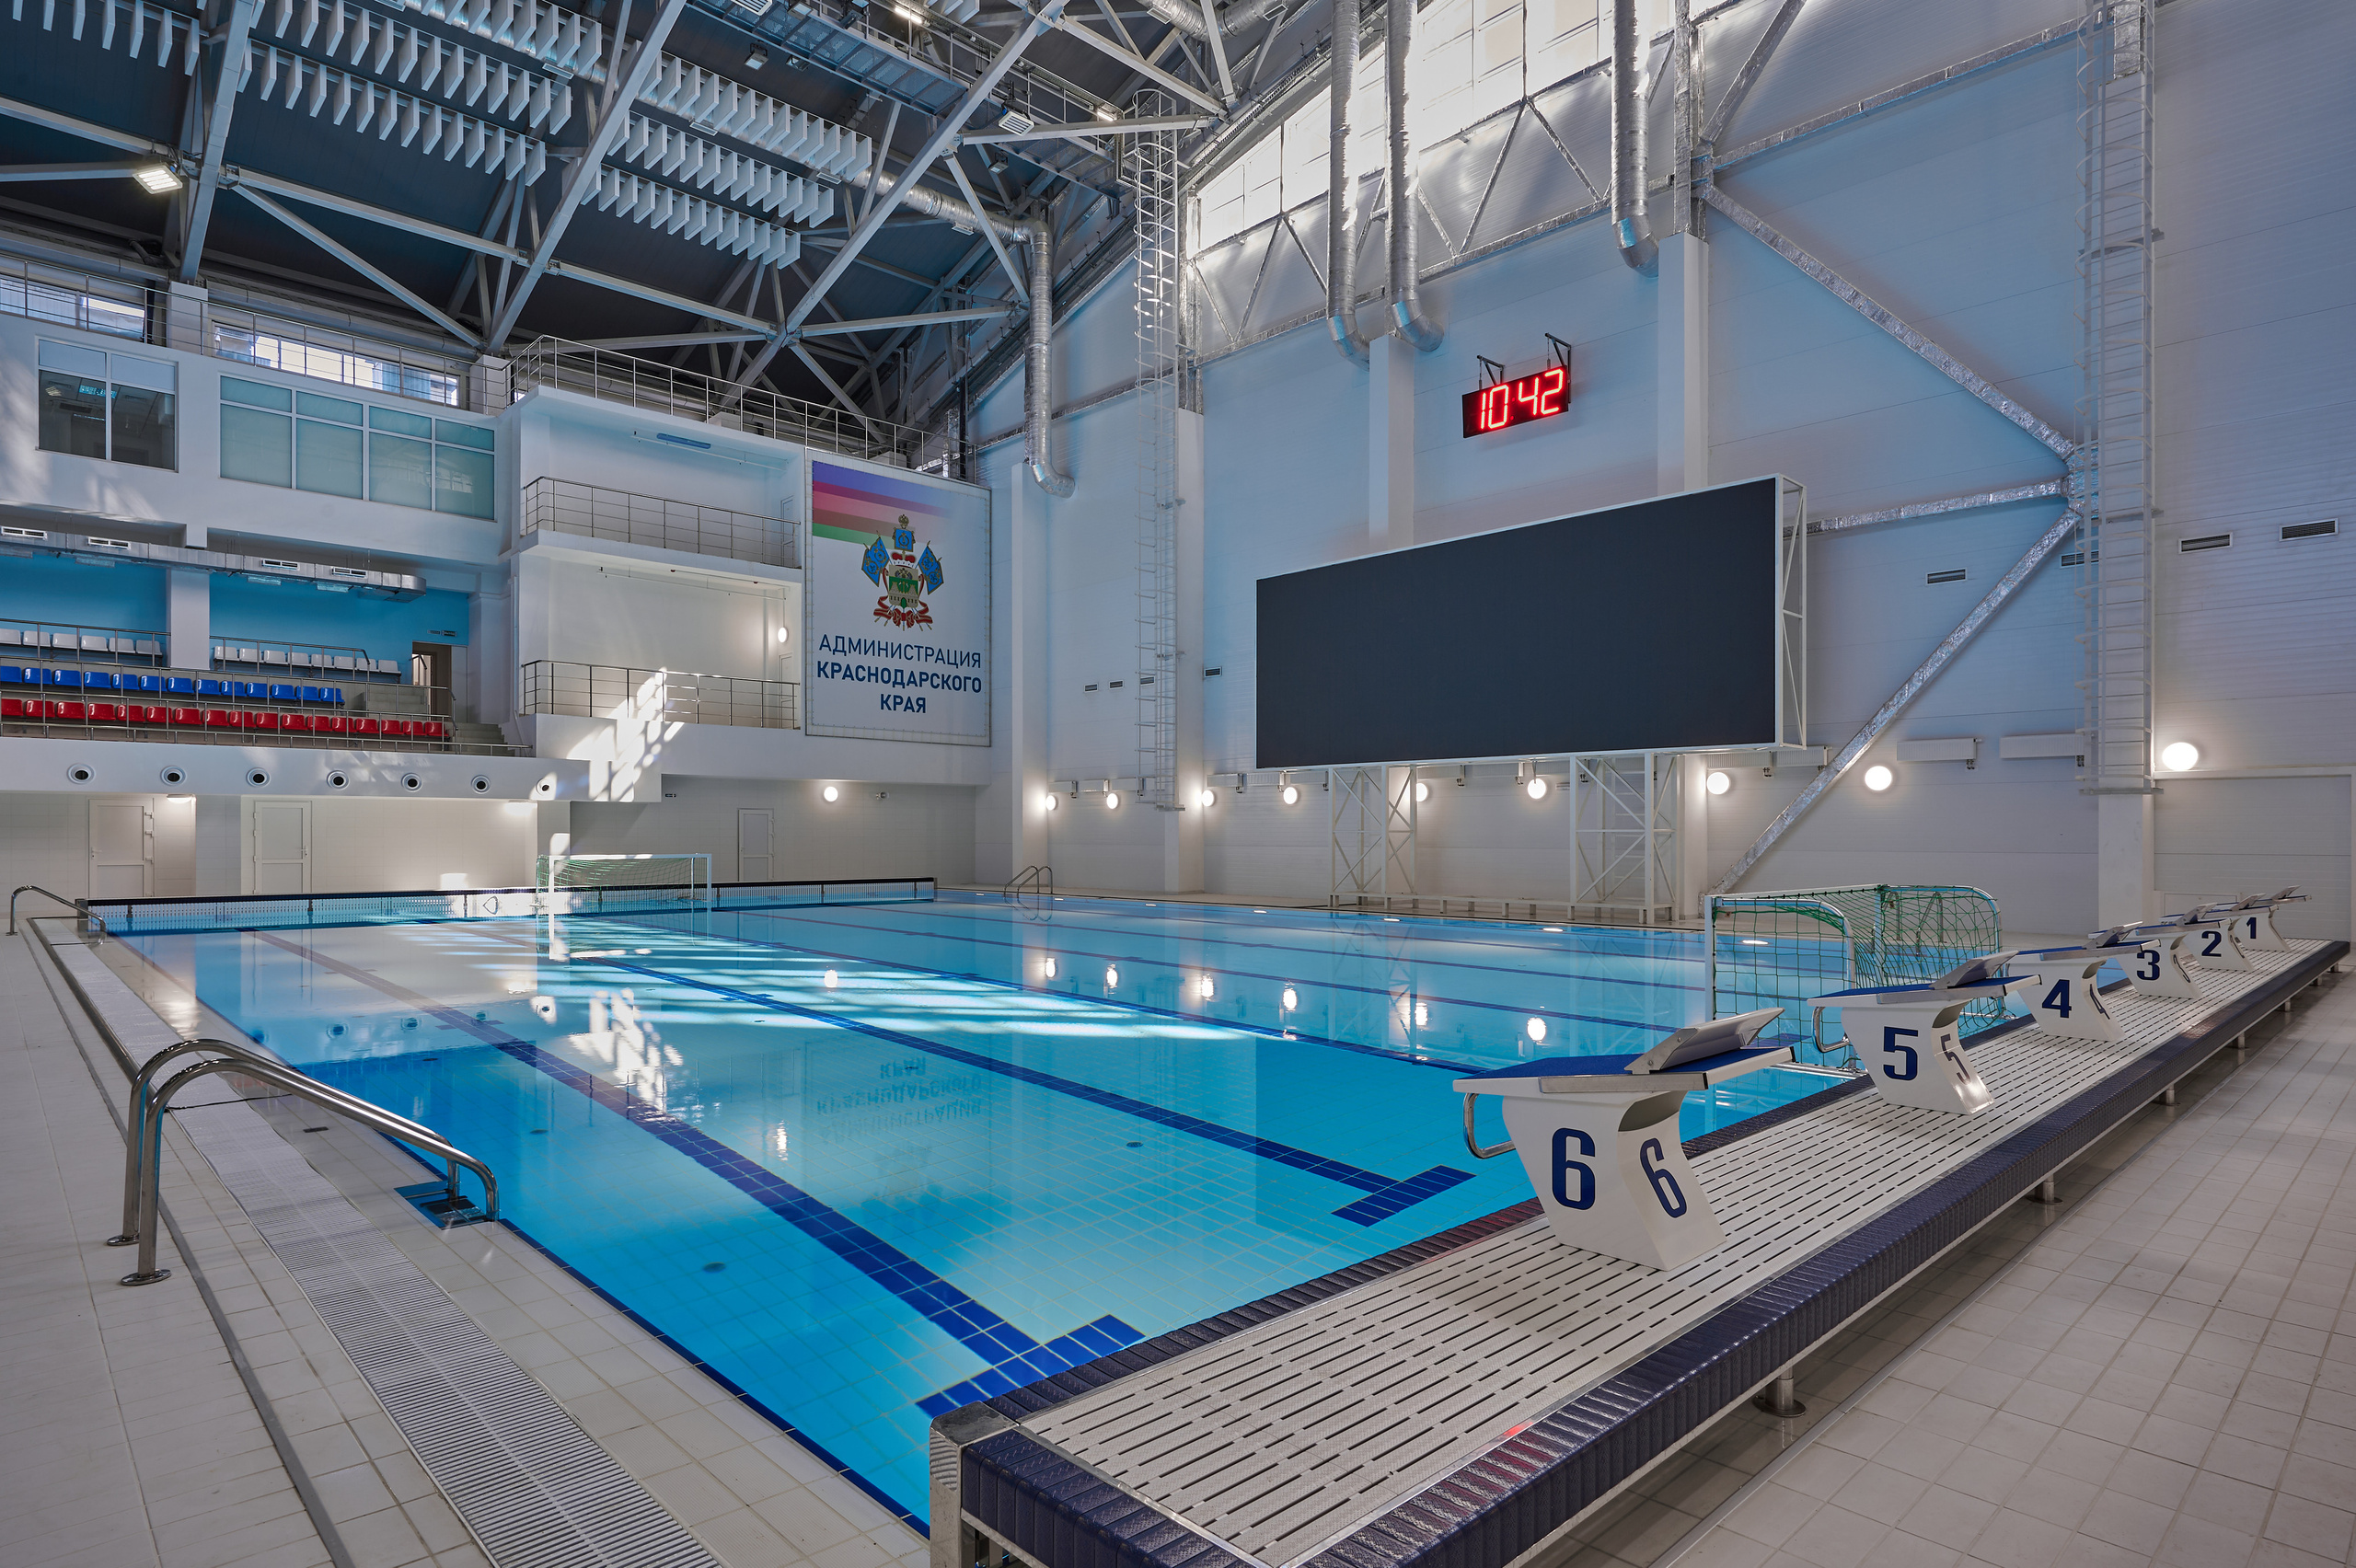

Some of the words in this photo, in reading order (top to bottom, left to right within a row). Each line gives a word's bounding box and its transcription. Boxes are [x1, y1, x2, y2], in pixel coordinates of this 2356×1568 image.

[818, 633, 981, 669] АДМИНИСТРАЦИЯ
[816, 660, 982, 694] КРАСНОДАРСКОГО
[880, 693, 927, 714] КРАЯ
[2200, 930, 2222, 958] 2
[2246, 917, 2258, 940] 1
[2136, 950, 2161, 981] 3
[2041, 978, 2073, 1019] 4
[2089, 983, 2110, 1020] 4
[1883, 1026, 1919, 1081] 5
[1940, 1033, 1972, 1086] 5
[1551, 1126, 1597, 1211] 6
[1639, 1137, 1688, 1219] 6
